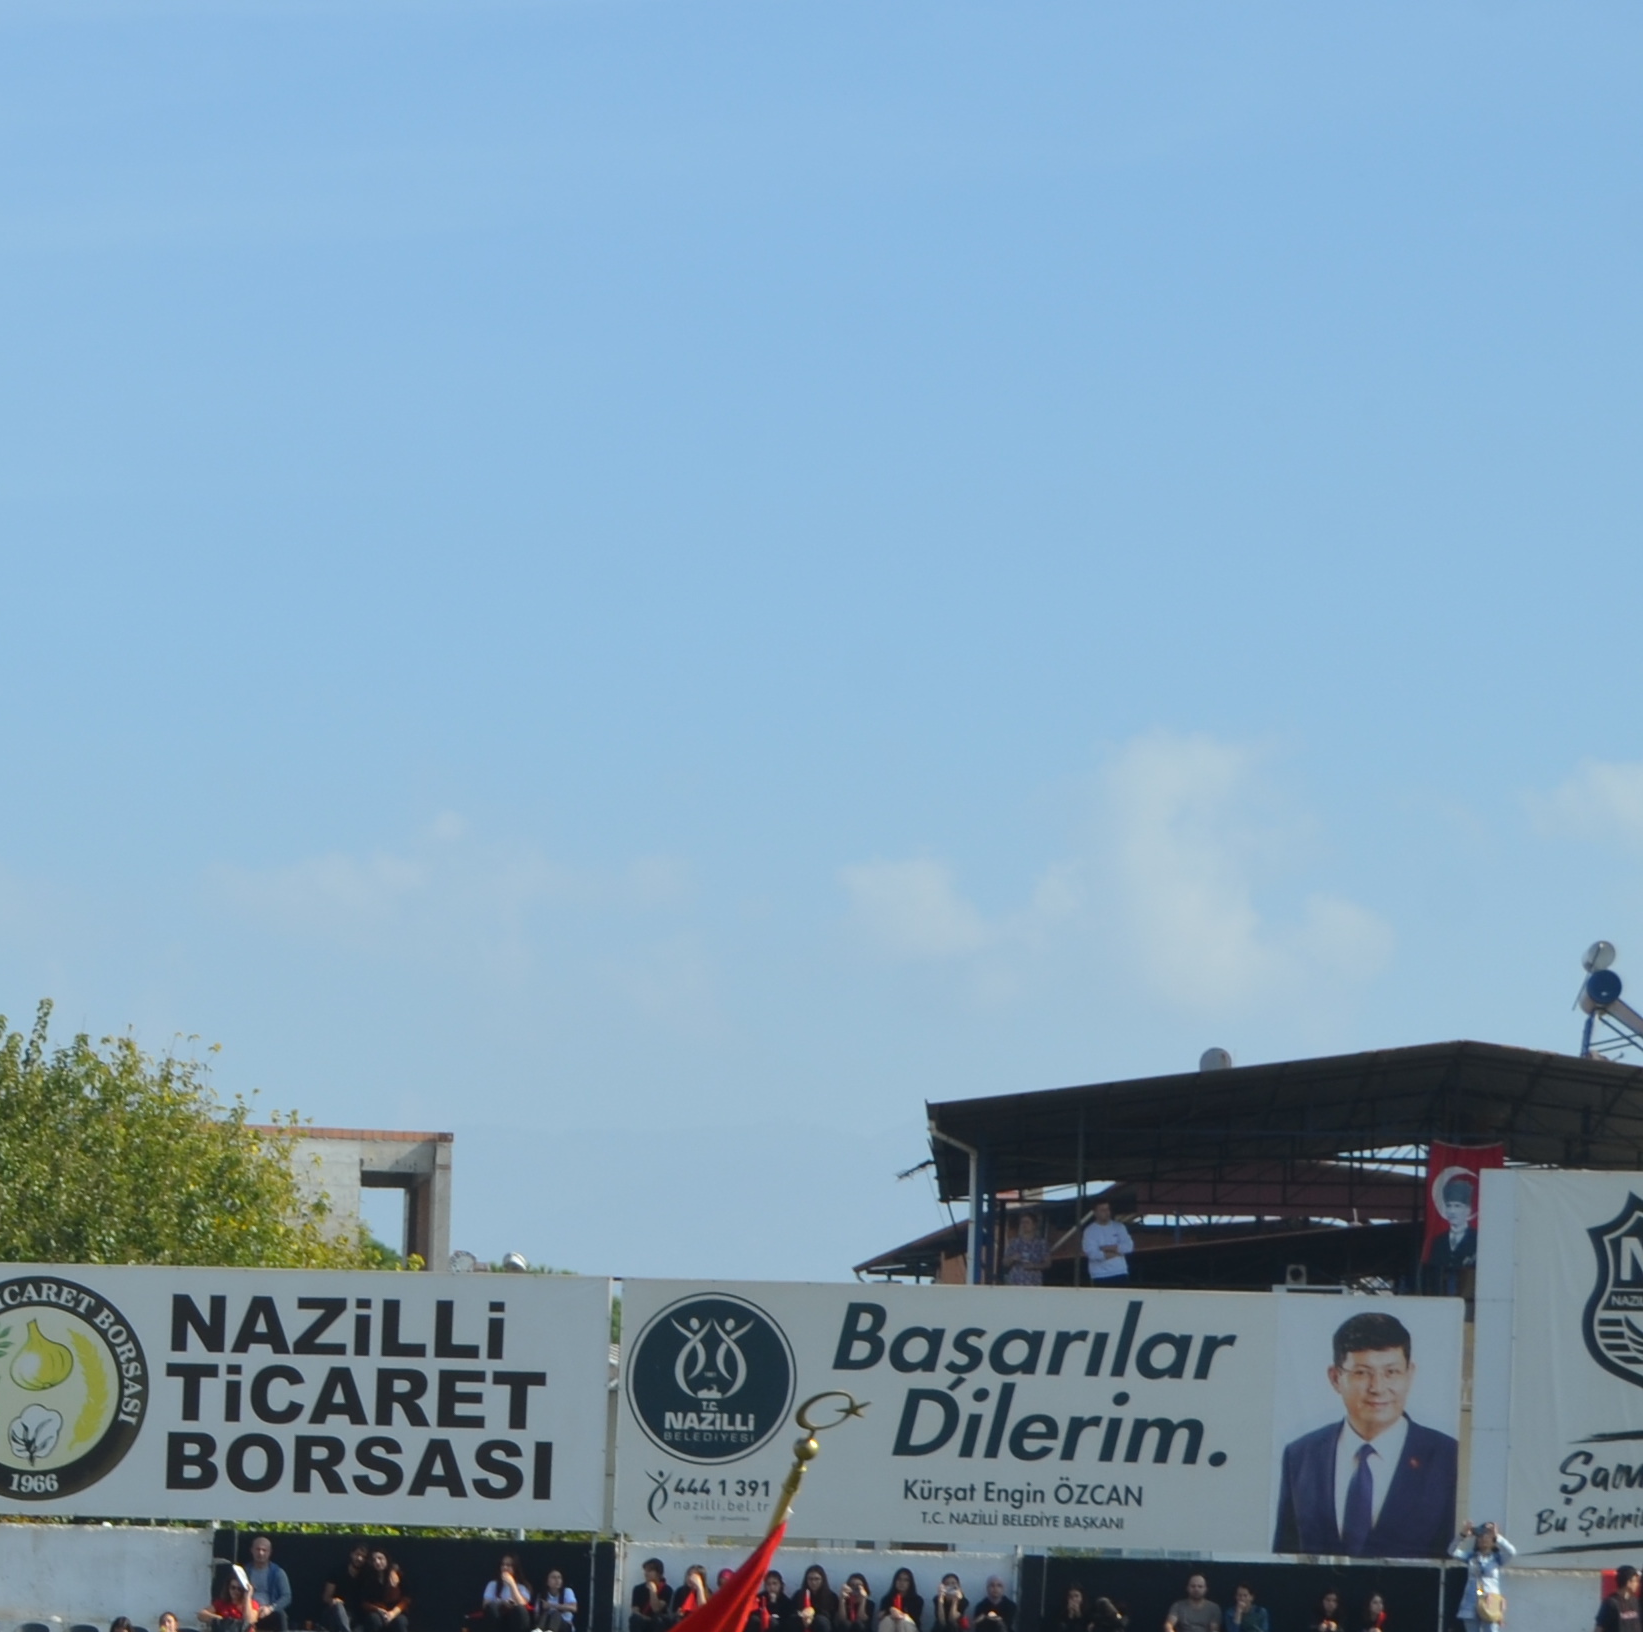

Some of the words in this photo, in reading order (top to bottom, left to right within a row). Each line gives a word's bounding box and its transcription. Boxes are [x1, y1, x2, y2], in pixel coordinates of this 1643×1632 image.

[832, 1300, 1238, 1392] Başarılar
[93, 1307, 143, 1425] BORSASI
[892, 1382, 1228, 1468] Dilerim.
[165, 1431, 553, 1501] BORSASI
[9, 1473, 59, 1493] 1966
[674, 1478, 711, 1495] 444
[718, 1479, 727, 1496] 1
[735, 1480, 771, 1498] 391
[903, 1479, 976, 1506] Kürşat
[983, 1481, 1045, 1509] Engin
[1053, 1476, 1144, 1507] ÖZCAN
[673, 1499, 771, 1513] nazilli.bel.tr
[921, 1511, 945, 1525] T.C.
[1064, 1516, 1125, 1531] BAŞKANI
[1536, 1509, 1567, 1536] Bu
